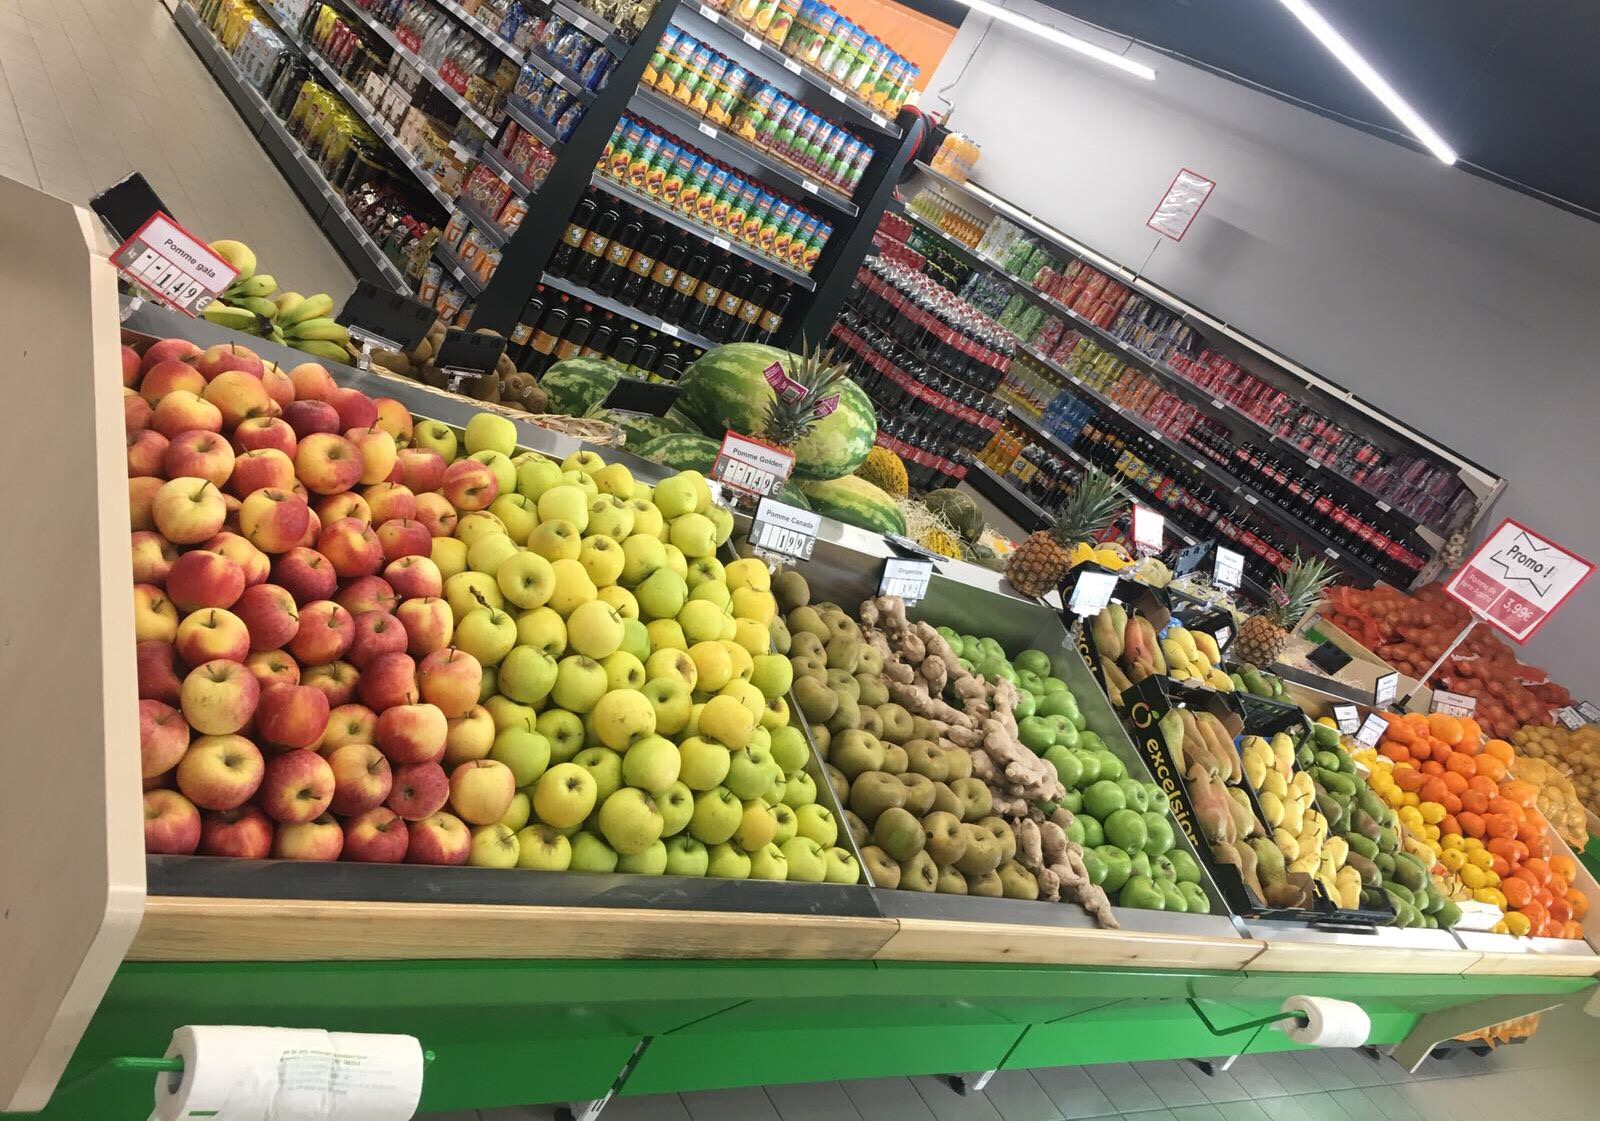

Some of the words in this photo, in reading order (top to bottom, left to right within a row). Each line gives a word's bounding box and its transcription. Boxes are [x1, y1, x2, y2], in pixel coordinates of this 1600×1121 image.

[164, 238, 197, 265] Pomme
[195, 262, 217, 279] gala
[732, 447, 758, 461] Pomme
[759, 455, 784, 469] Golden
[766, 509, 790, 522] Pomme
[790, 517, 814, 529] Canada
[1506, 544, 1544, 574] Promo
[1503, 598, 1534, 622] 3,99€
[1145, 738, 1199, 847] excelsior
